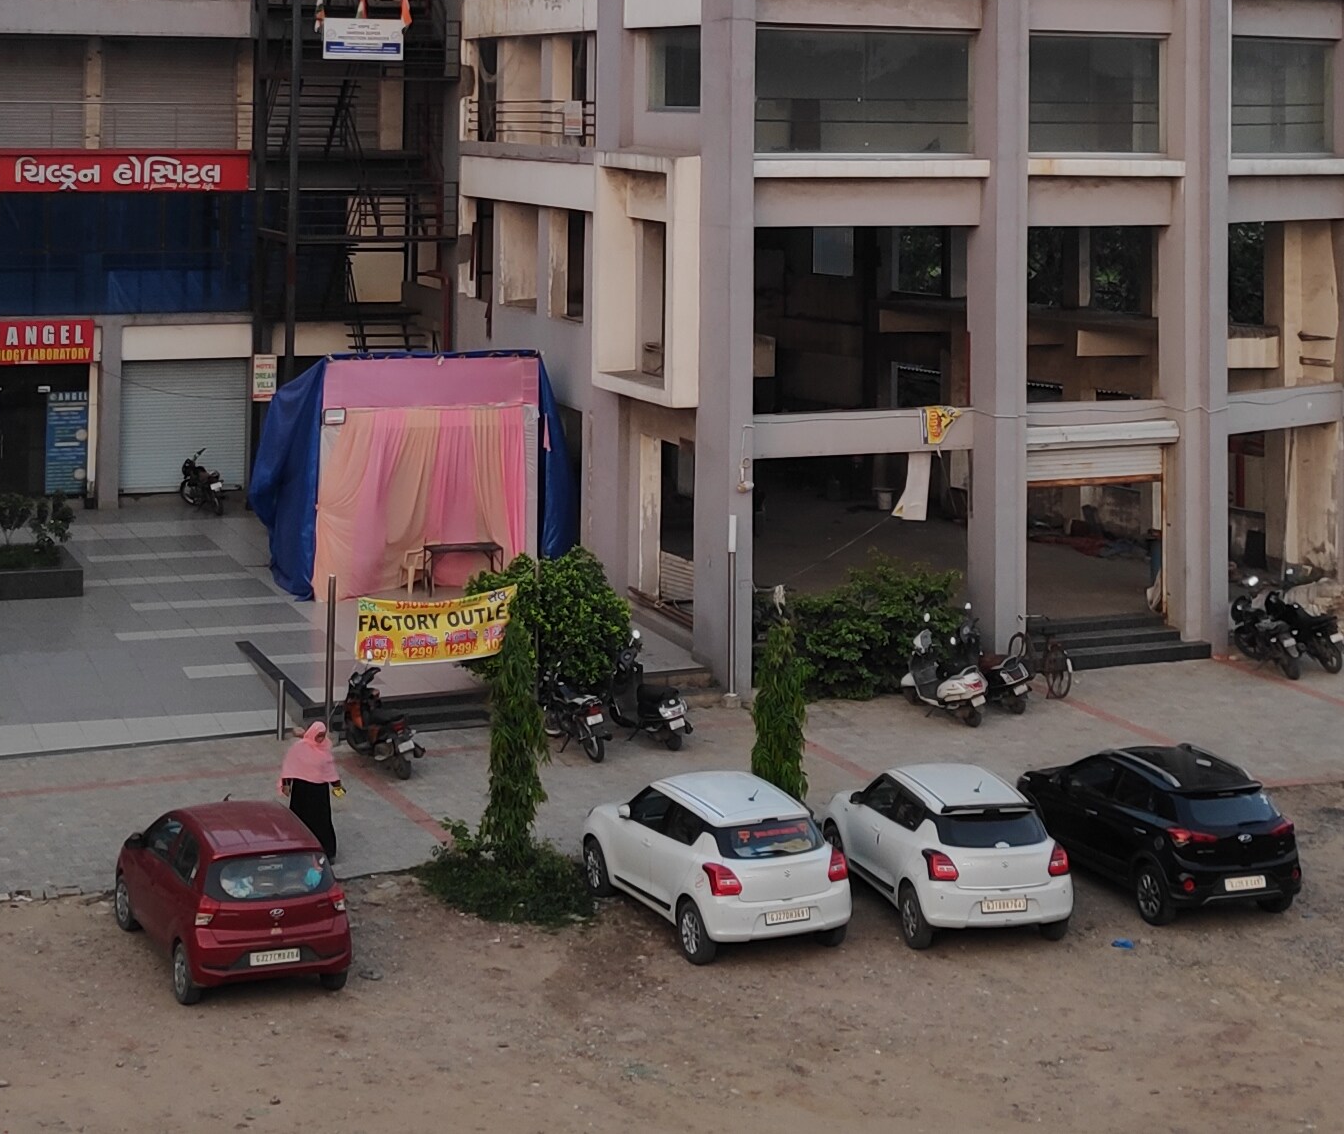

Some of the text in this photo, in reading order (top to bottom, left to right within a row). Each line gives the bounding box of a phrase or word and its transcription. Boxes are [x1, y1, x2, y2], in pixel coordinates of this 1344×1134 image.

[15, 156, 100, 190] ચિલ્ડ્રન
[113, 156, 220, 184] હોસ્પિટલ
[6, 325, 84, 346] ANGEL
[27, 347, 91, 361] LABORATORY
[58, 391, 87, 401] ANGEL
[359, 603, 508, 632] FACTORY OUTLE
